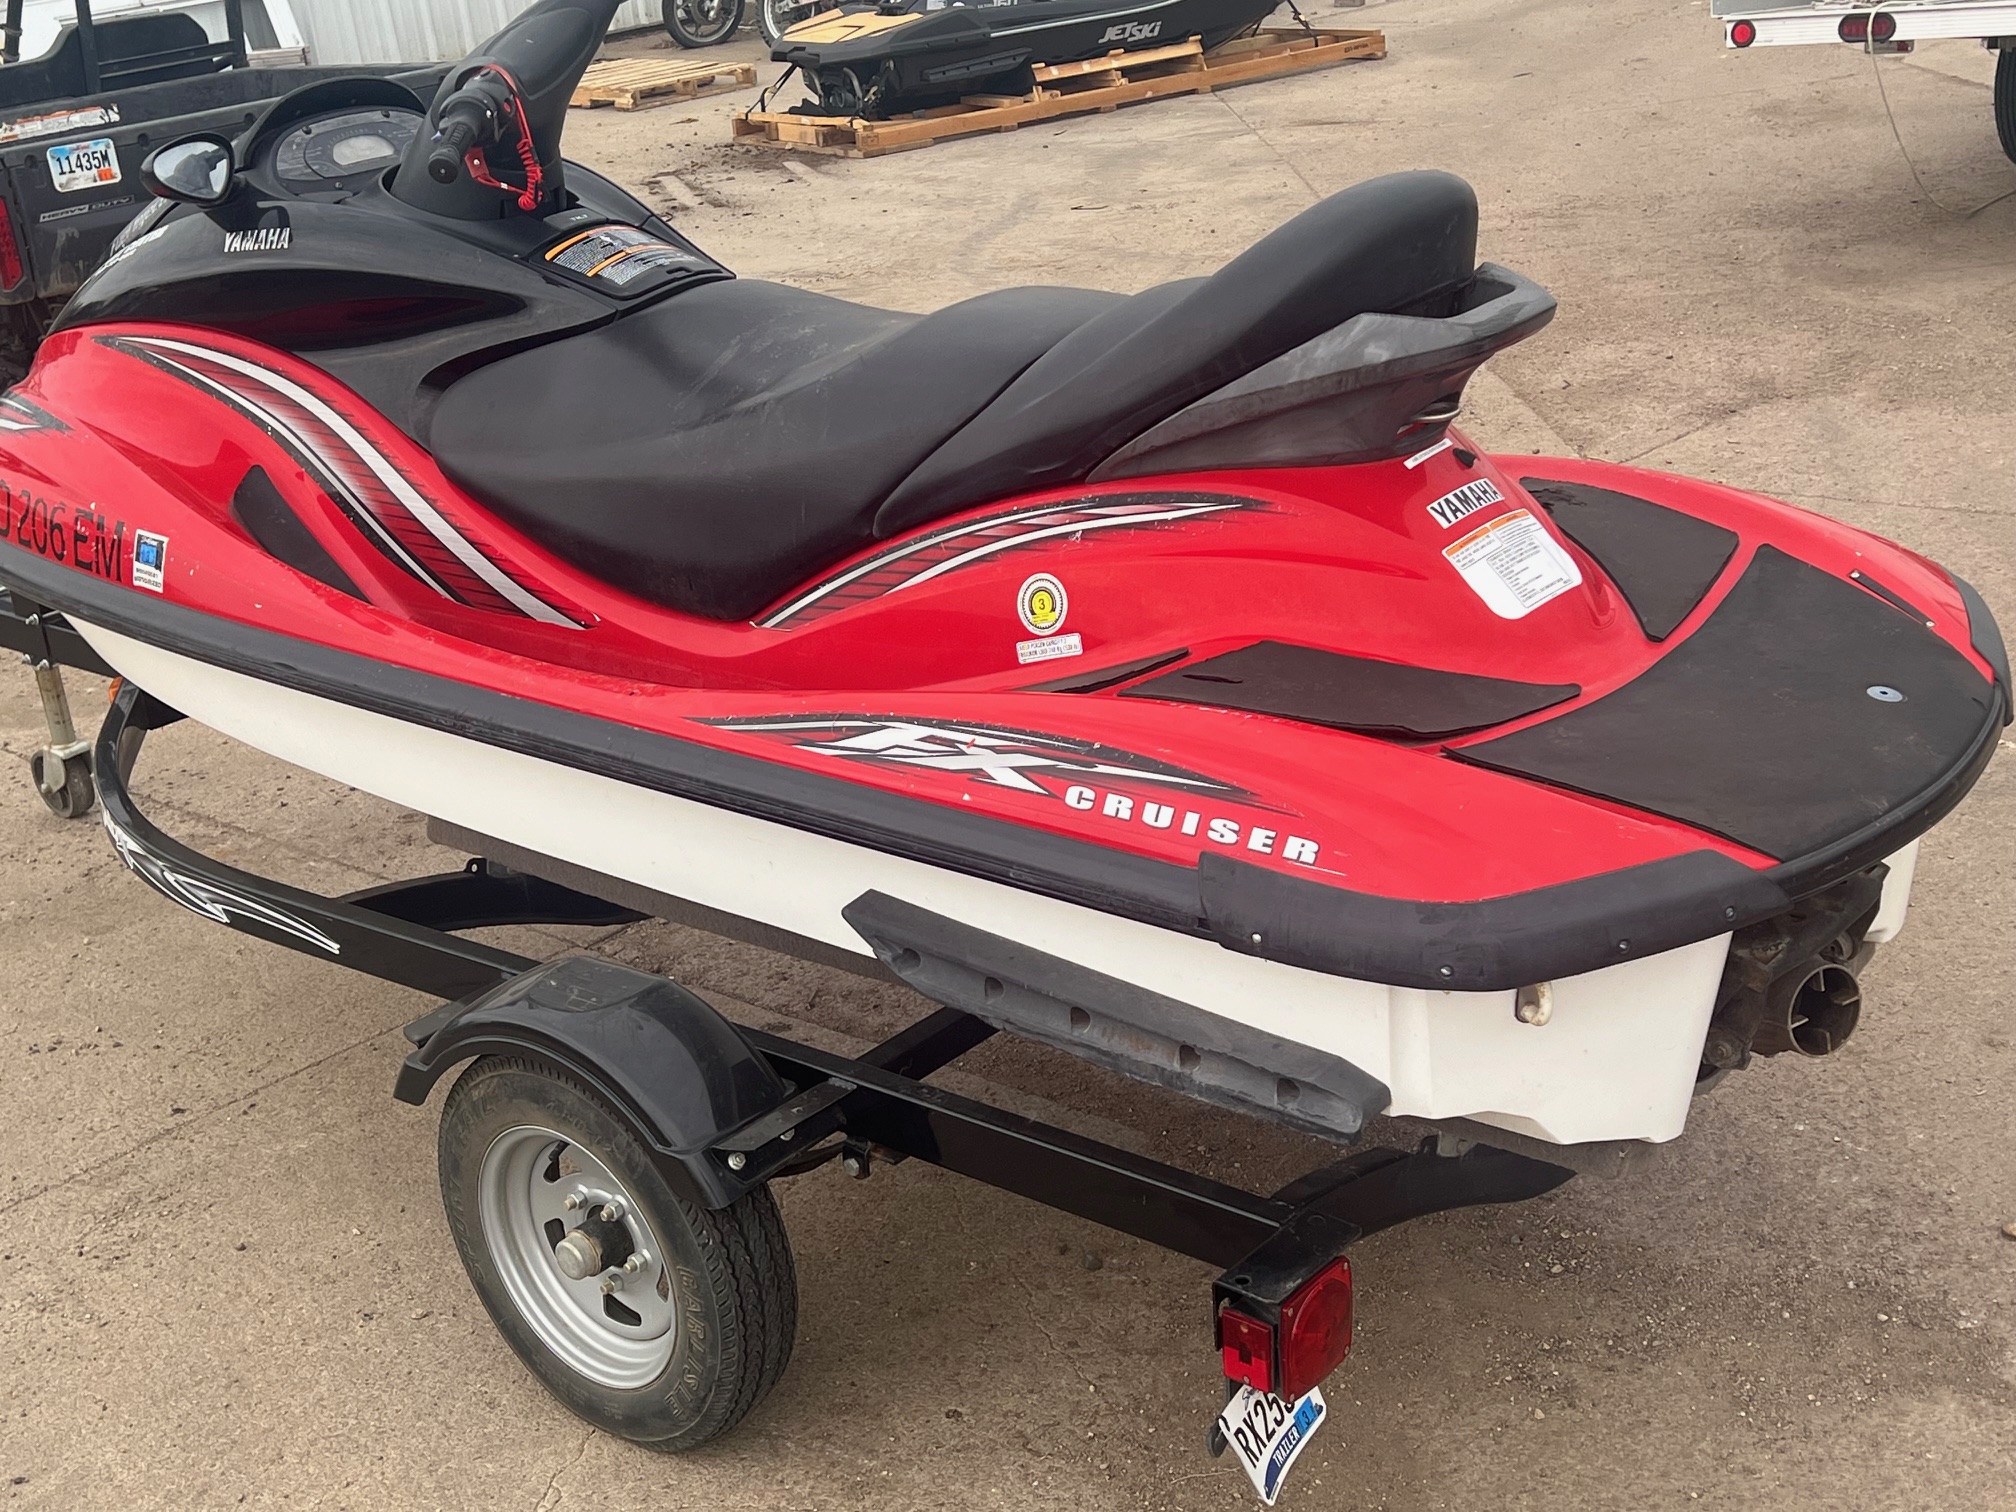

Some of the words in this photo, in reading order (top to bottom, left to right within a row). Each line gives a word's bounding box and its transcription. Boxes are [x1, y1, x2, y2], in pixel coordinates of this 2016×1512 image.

[56, 149, 111, 176] 11435M
[223, 227, 290, 252] YAMAHA
[1429, 480, 1500, 524] YAMAHA
[17, 489, 66, 561] 206
[74, 508, 125, 582] EM
[1063, 783, 1321, 865] CRUISER
[665, 1265, 705, 1418] CARLISLE
[1272, 1425, 1300, 1467] TRAILER
